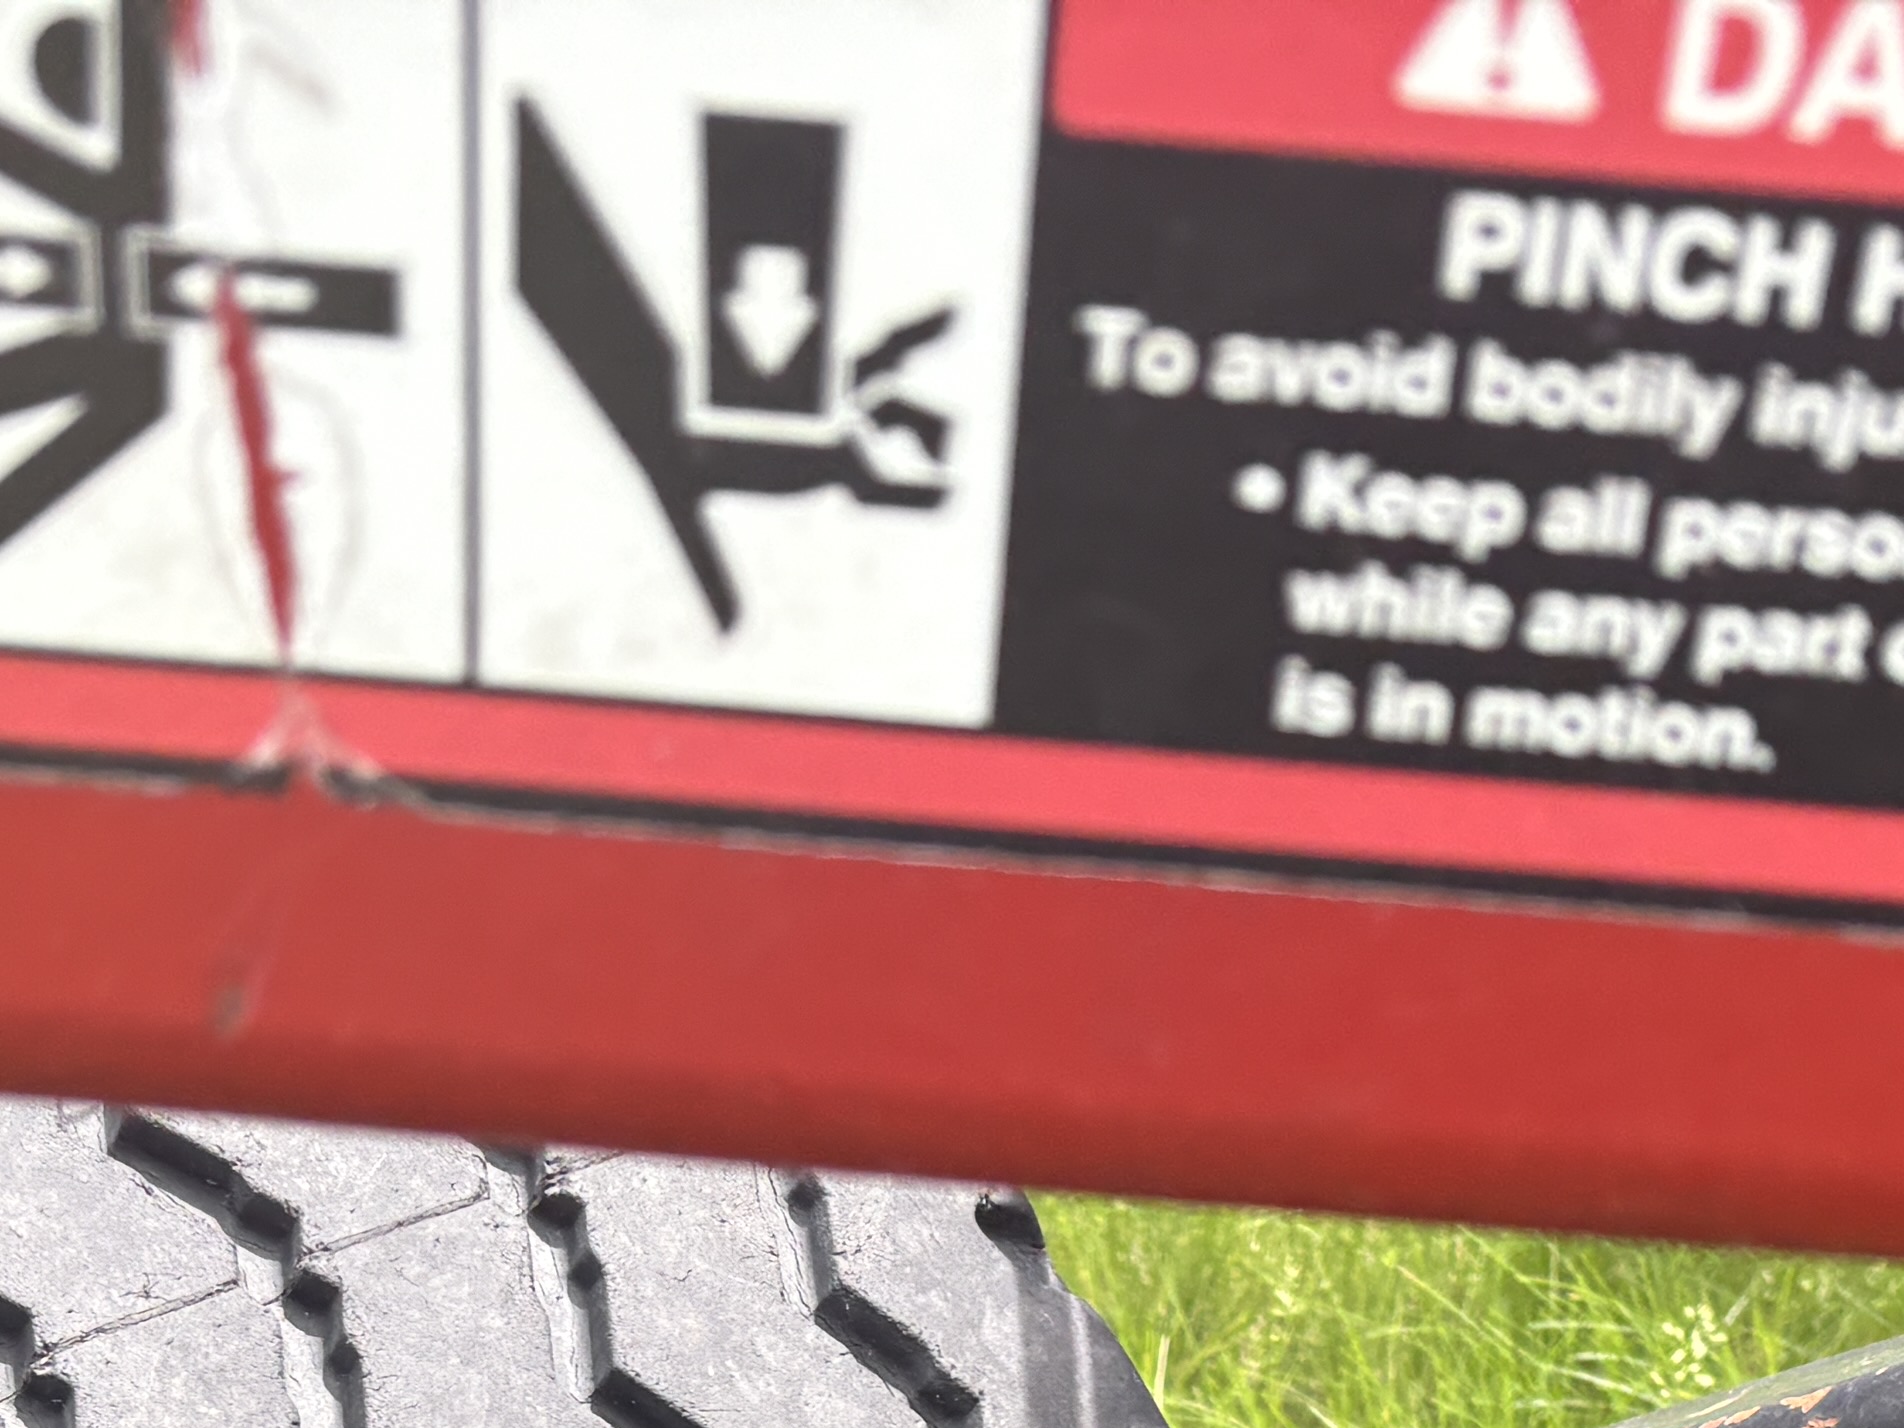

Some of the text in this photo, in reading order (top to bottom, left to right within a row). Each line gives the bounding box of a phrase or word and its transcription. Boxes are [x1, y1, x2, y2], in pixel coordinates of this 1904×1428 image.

[1441, 192, 1832, 327] PINCH
[1082, 307, 1196, 394] To
[1211, 334, 1453, 415] avoid
[1468, 343, 1739, 456] bodily
[1301, 455, 1524, 558] Keep
[1538, 480, 1649, 553] all
[1289, 564, 1511, 647] while
[1525, 592, 1683, 676] any
[1695, 607, 1870, 681] part
[1276, 659, 1771, 767] is in motion.
